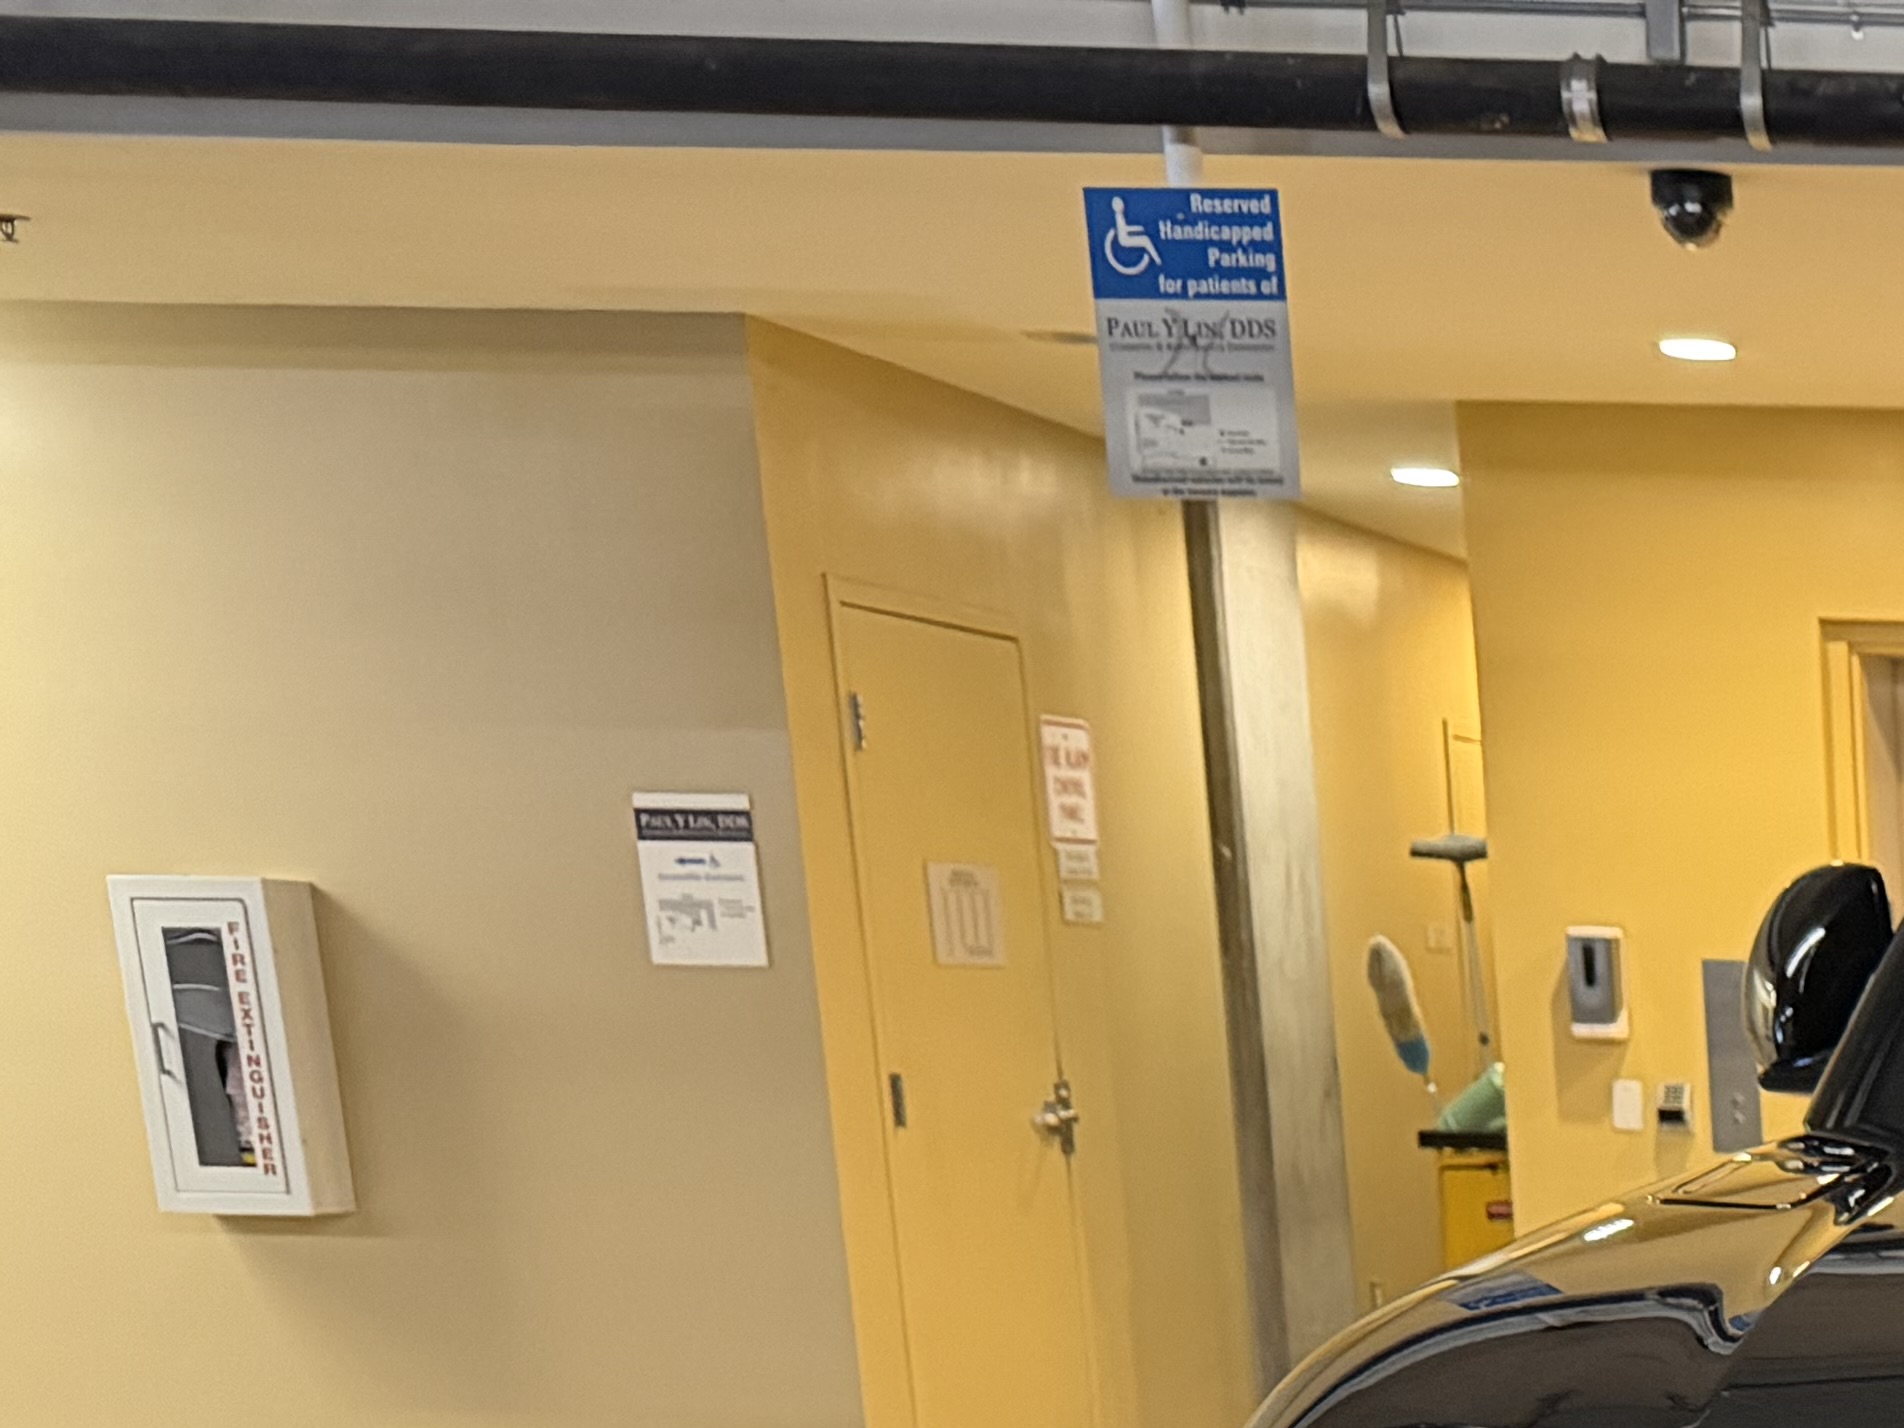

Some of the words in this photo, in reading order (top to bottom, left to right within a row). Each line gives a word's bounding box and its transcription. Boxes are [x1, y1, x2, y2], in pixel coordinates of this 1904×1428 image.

[1190, 193, 1271, 214] Reserved
[1158, 220, 1275, 247] Handicapped
[1207, 247, 1277, 272] Parking
[1158, 273, 1183, 294] for
[1187, 274, 1257, 299] patients
[1260, 275, 1279, 295] of
[1106, 317, 1159, 338] PAUL
[1229, 318, 1277, 339] DDS
[227, 921, 247, 984] FIRE
[237, 991, 278, 1176] EXTINGUISHER
